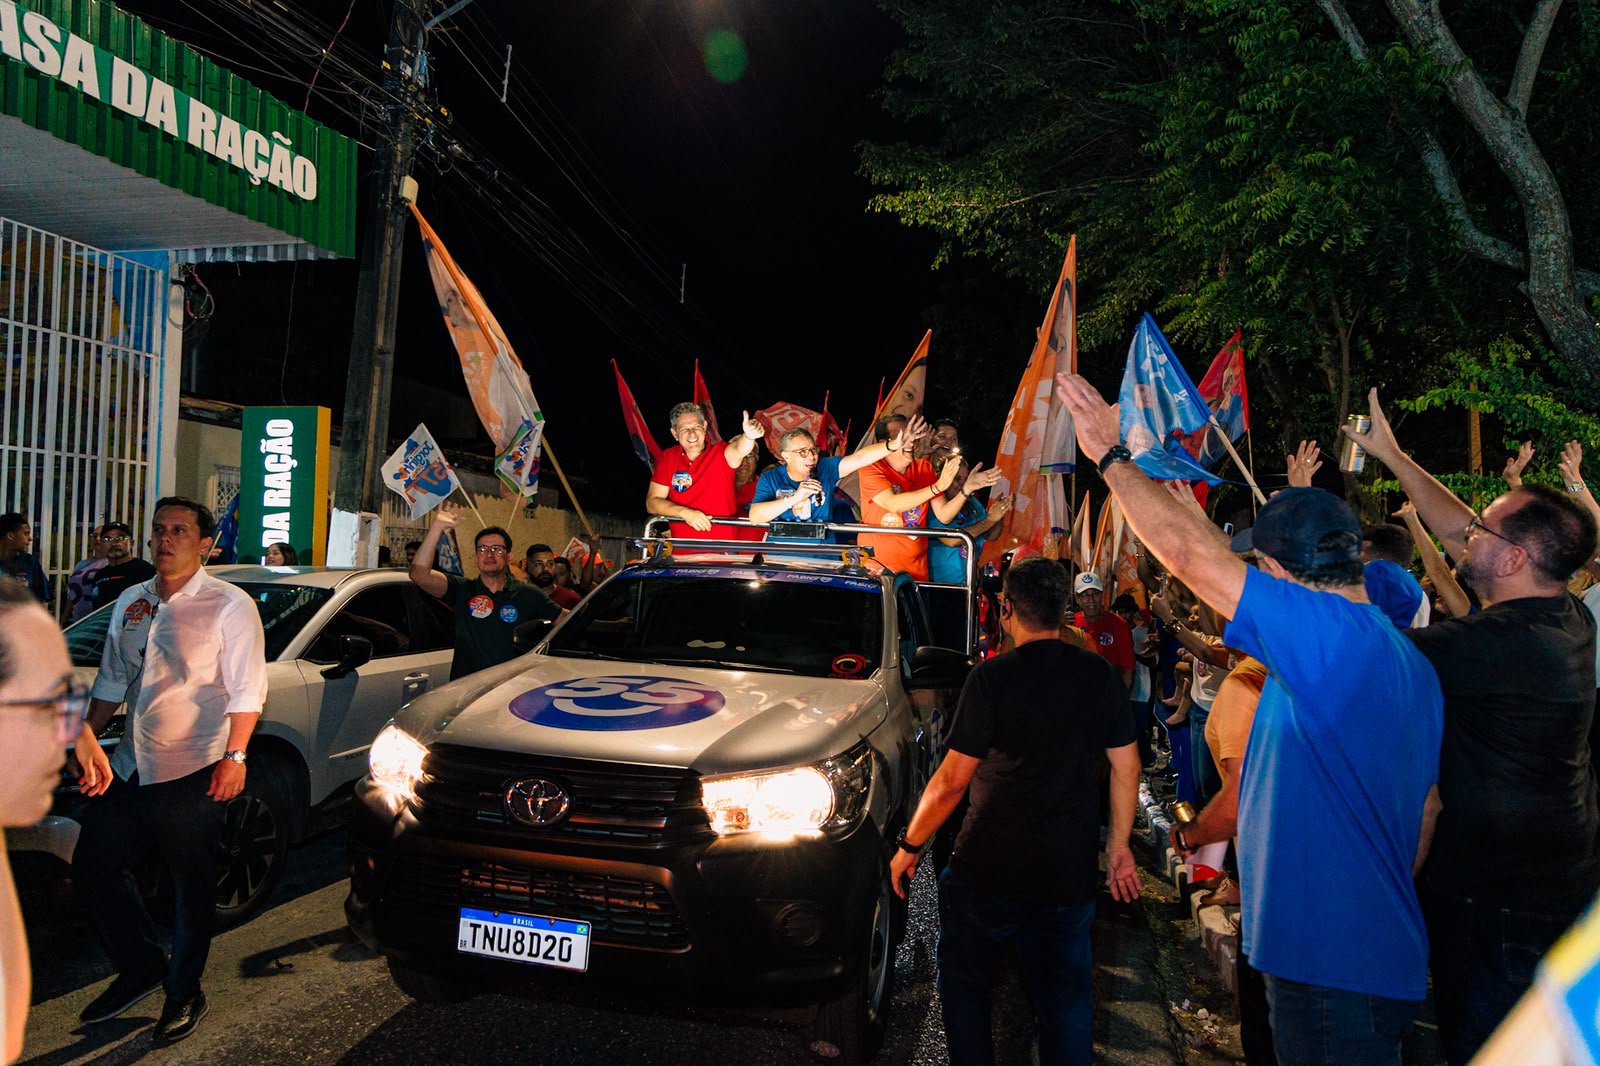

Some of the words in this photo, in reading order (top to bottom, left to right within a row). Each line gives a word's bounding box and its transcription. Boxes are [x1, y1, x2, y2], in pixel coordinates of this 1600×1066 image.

[112, 55, 179, 137] DA
[187, 97, 317, 200] RAÇÃO
[260, 419, 298, 507] RAÇÃO
[262, 512, 290, 547] DA
[544, 677, 718, 705] 55
[512, 917, 534, 927] BRASIL
[469, 923, 573, 963] TNU8D20
